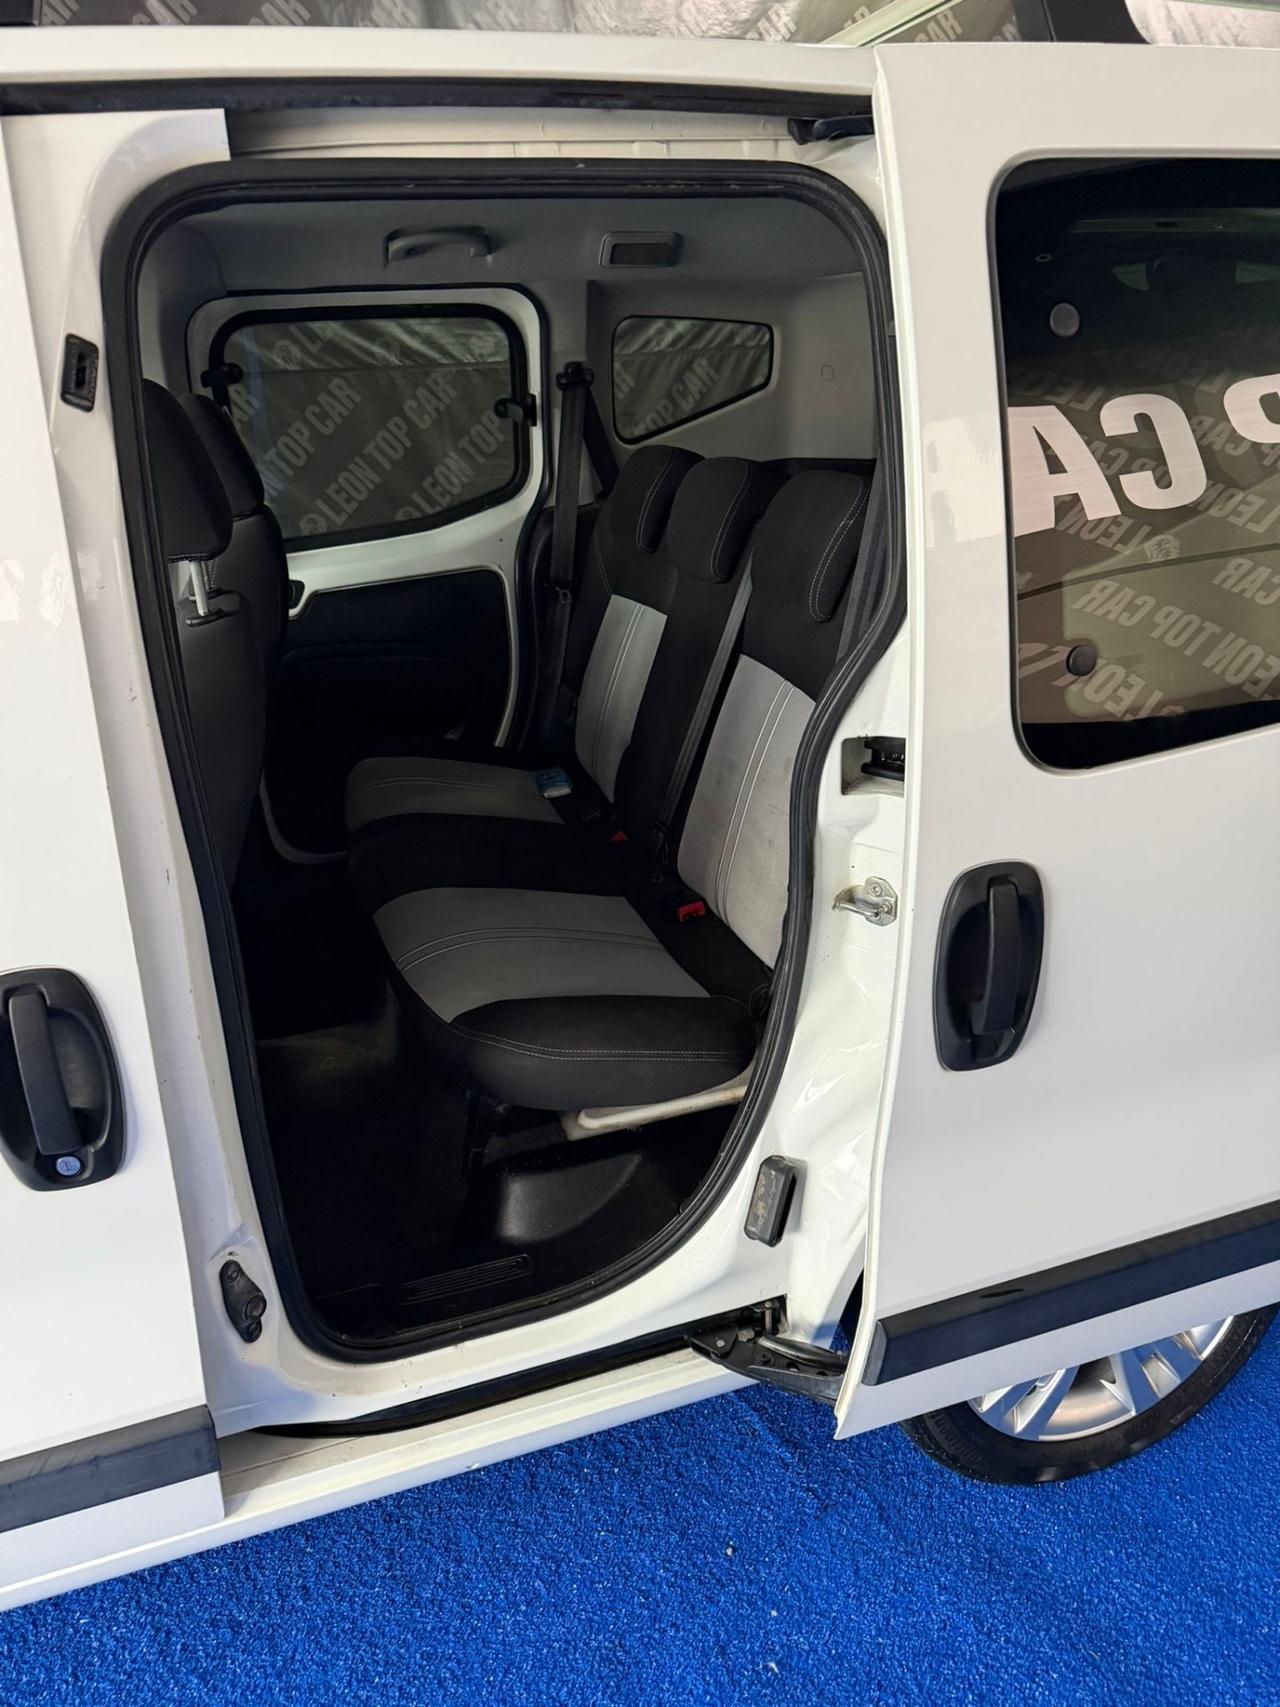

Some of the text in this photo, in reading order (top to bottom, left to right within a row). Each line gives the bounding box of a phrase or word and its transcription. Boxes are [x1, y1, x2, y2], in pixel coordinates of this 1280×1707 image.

[262, 421, 317, 478] TOP
[304, 376, 361, 436] CAR
[671, 356, 720, 412] CAR
[316, 369, 458, 526] LEON TOP CAR
[411, 409, 506, 517] LEON TOP
